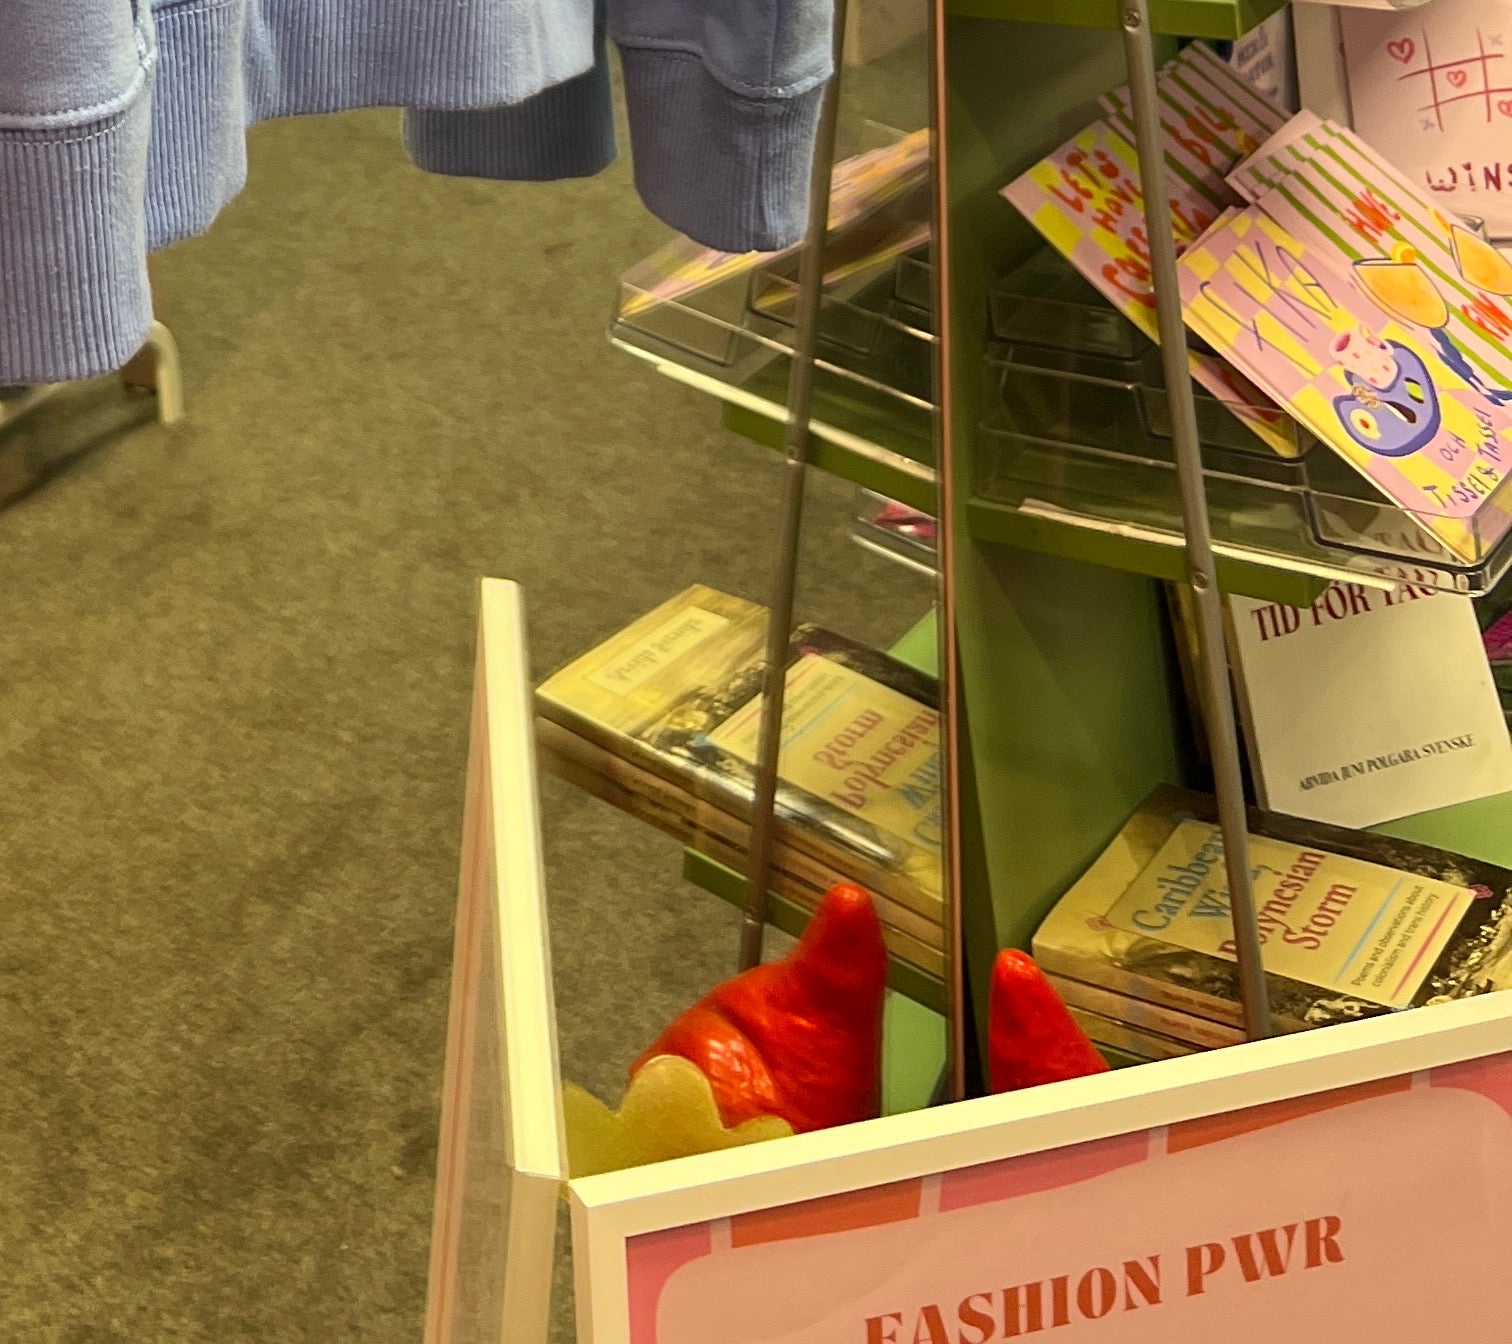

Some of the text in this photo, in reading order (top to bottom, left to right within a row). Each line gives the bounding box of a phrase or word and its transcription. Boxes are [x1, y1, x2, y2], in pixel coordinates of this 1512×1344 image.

[1200, 240, 1338, 376] FIKA
[1251, 602, 1302, 642] TID
[1281, 883, 1358, 951] Storm
[864, 1215, 1346, 1344] FASHION PWR
